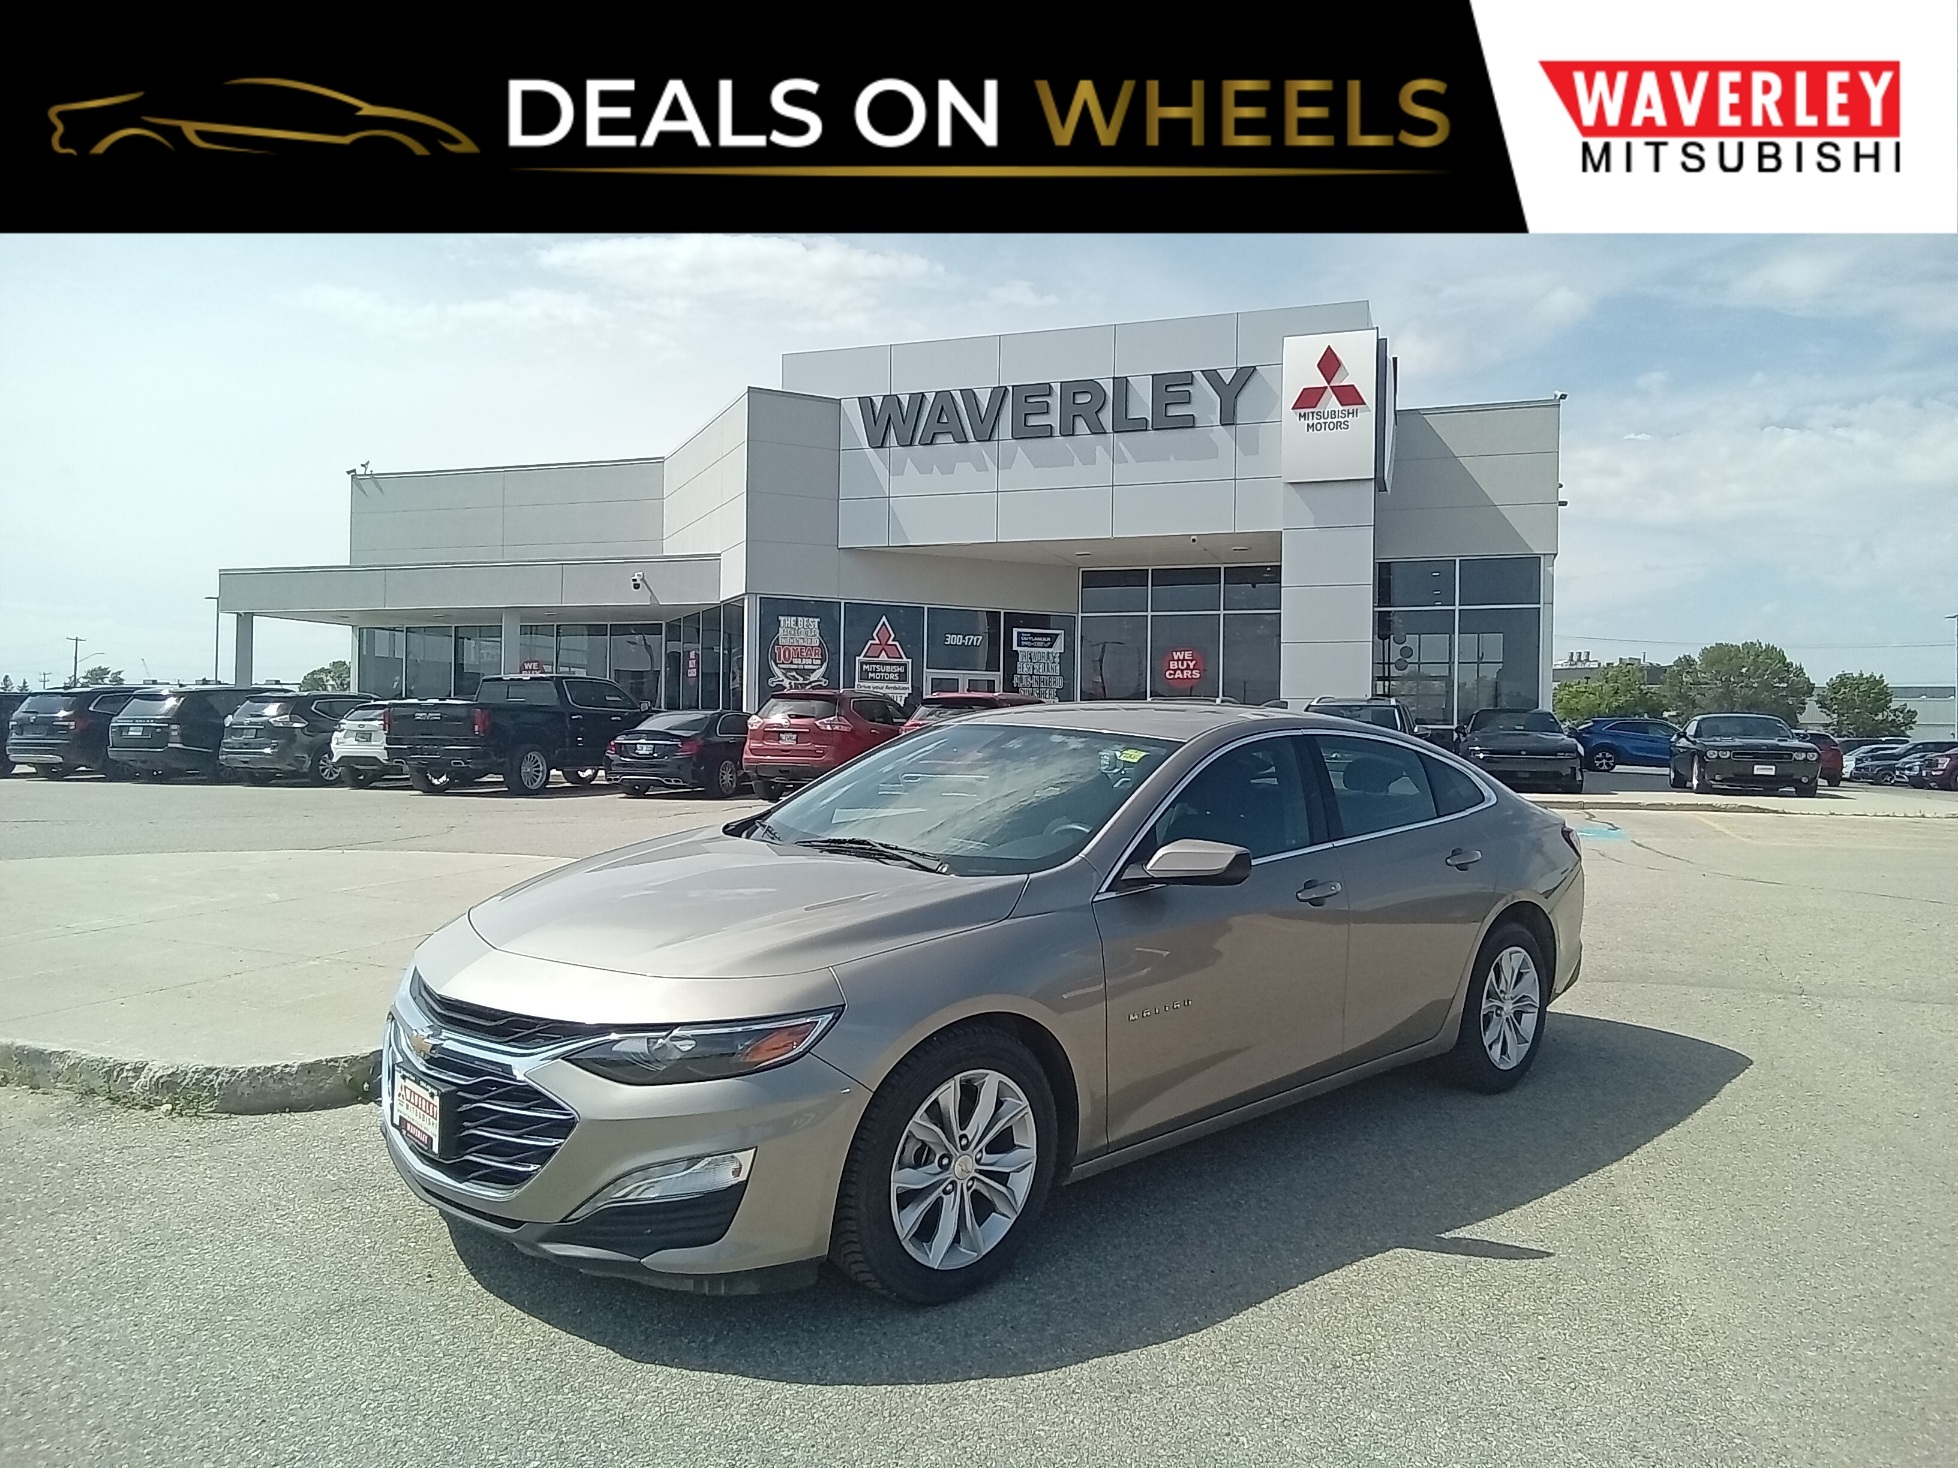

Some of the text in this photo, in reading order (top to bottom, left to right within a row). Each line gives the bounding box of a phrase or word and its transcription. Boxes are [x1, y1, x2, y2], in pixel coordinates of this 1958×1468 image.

[858, 365, 1257, 448] WAVERLEY
[1298, 408, 1359, 422] MITSUBISHI
[1306, 420, 1350, 433] MOTORS
[778, 616, 821, 629] THE BEST
[944, 633, 983, 646] 300-1717
[775, 646, 822, 664] 10 YEAR
[1172, 650, 1193, 660] WE
[523, 662, 539, 670] WE
[862, 663, 905, 673] MITSUBISHI
[1169, 660, 1197, 670] BUY
[868, 672, 900, 681] MOTORS
[1165, 669, 1201, 679] CARS
[405, 1086, 438, 1121] WAVERLEY
